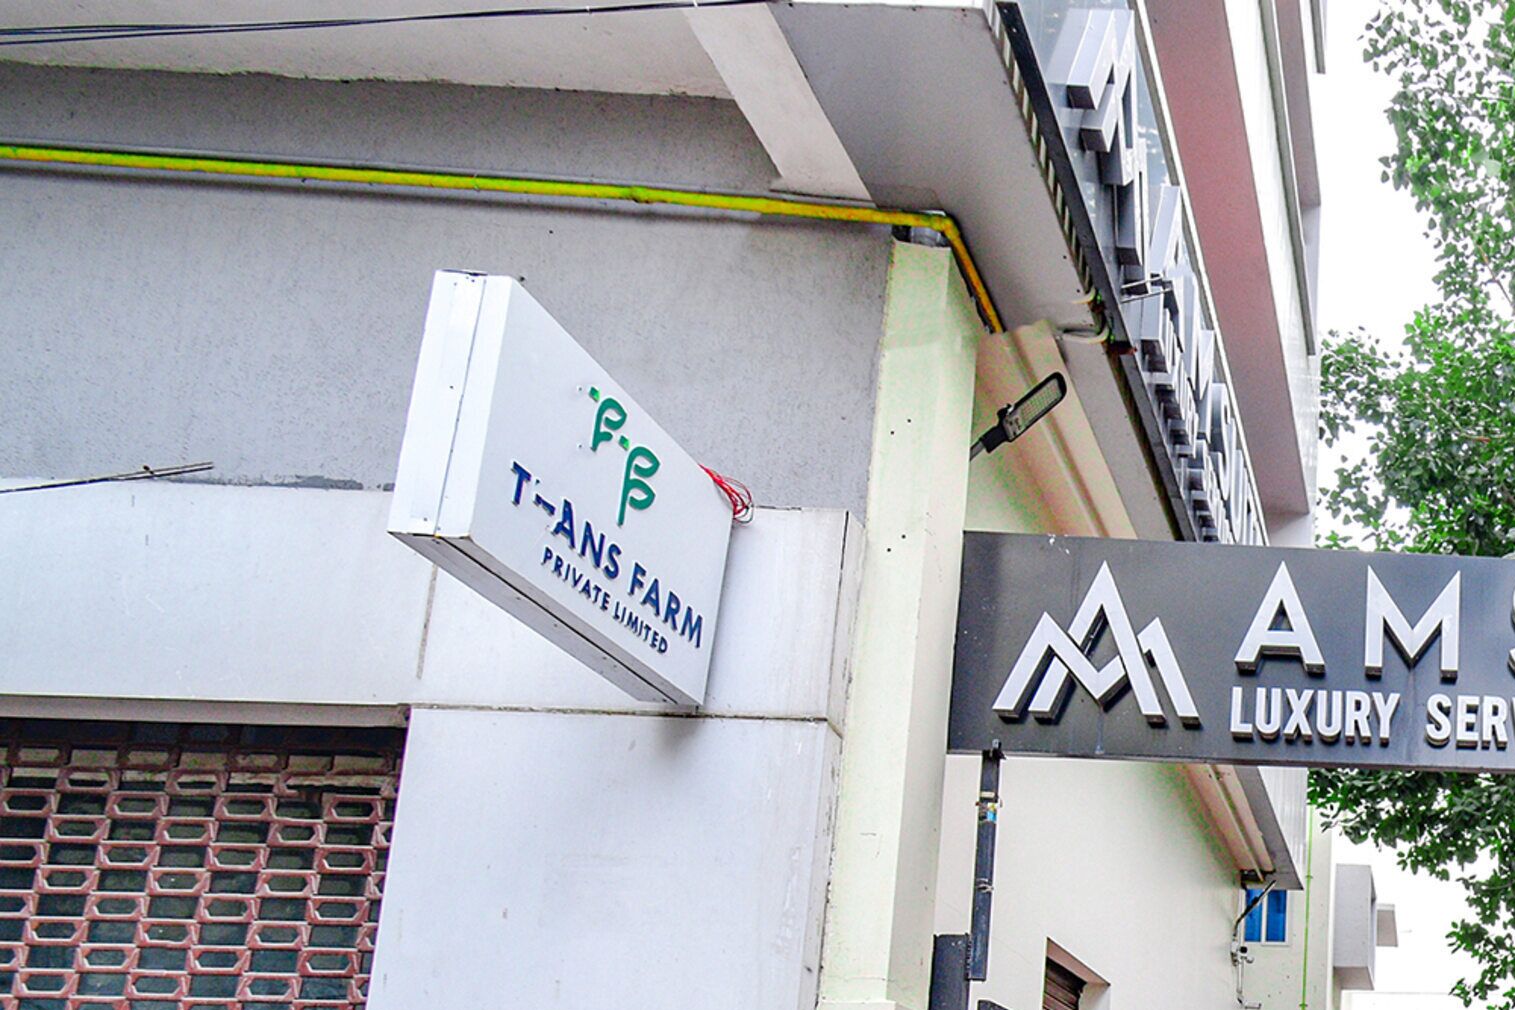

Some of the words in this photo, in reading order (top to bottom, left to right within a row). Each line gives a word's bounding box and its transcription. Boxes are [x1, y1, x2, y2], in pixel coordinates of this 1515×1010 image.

[511, 461, 622, 580] TANS
[627, 562, 704, 649] FARM
[541, 546, 611, 611] PRIVATE
[612, 600, 669, 655] LIMITED
[1230, 686, 1400, 746] LUXURY
